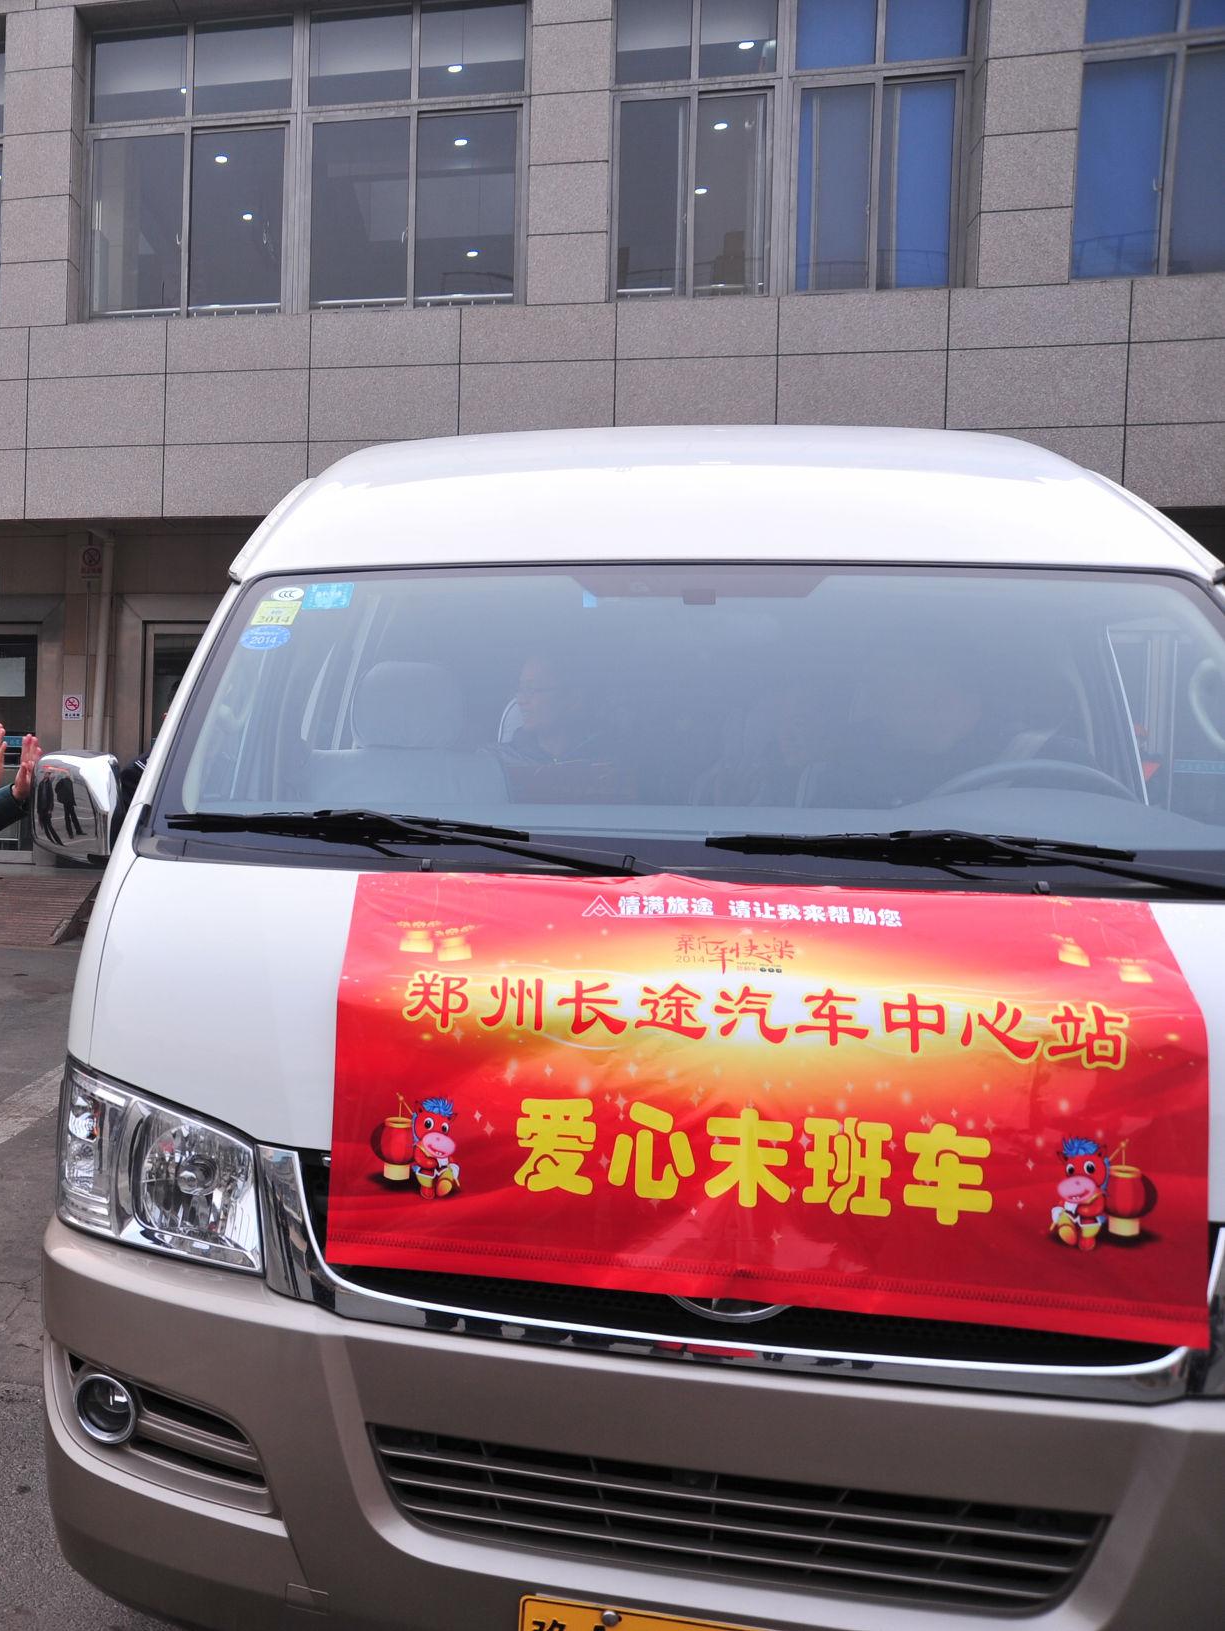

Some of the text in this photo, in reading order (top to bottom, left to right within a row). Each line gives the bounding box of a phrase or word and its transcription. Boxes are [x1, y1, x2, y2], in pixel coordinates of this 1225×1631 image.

[256, 615, 291, 624] 2014
[249, 635, 277, 645] 2014
[617, 895, 903, 928] 情满旅途 请让我来帮助您
[675, 955, 706, 964] 2014
[404, 970, 1130, 1071] 郑州长途汽车中心站
[513, 1097, 993, 1226] 爱心末班车
